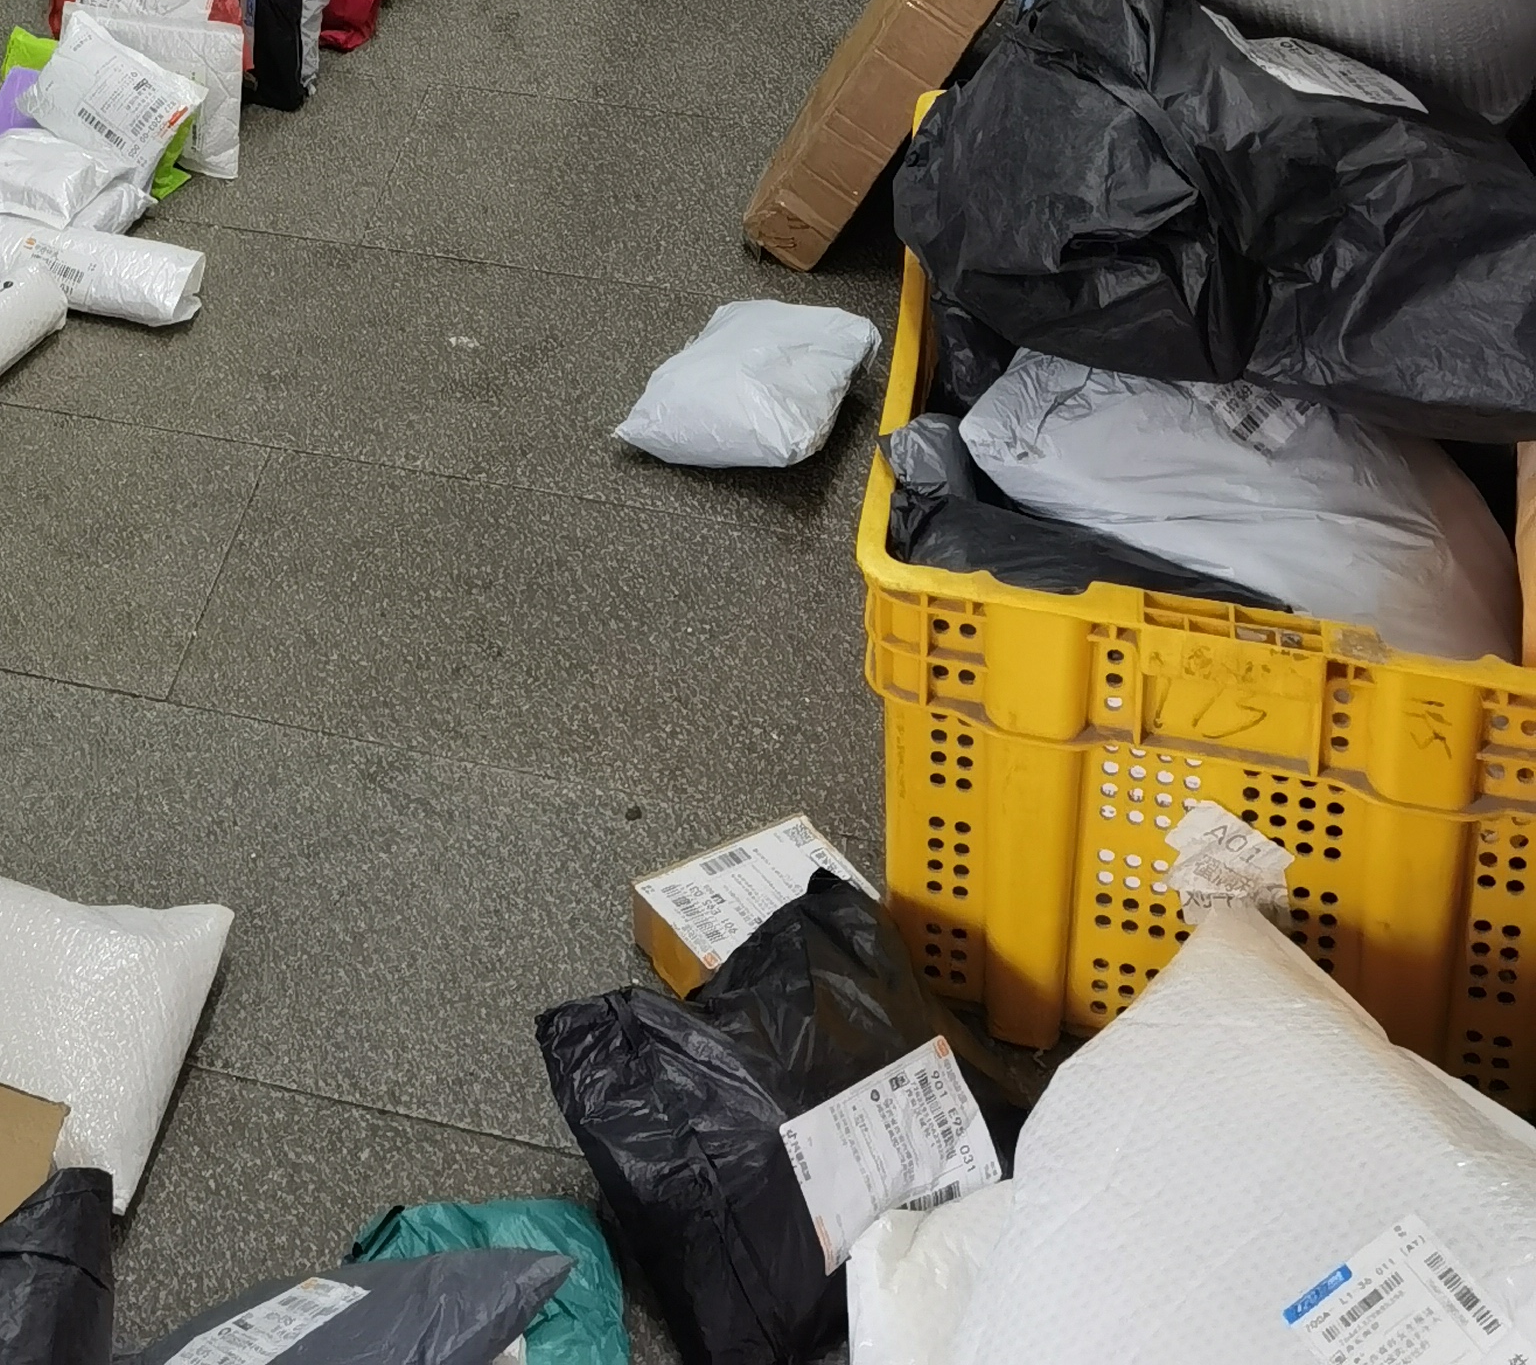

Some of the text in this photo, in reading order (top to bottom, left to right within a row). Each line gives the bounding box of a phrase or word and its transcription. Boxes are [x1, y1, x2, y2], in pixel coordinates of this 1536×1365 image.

[1203, 824, 1263, 865] A01
[930, 1069, 977, 1174] 901 E95 031
